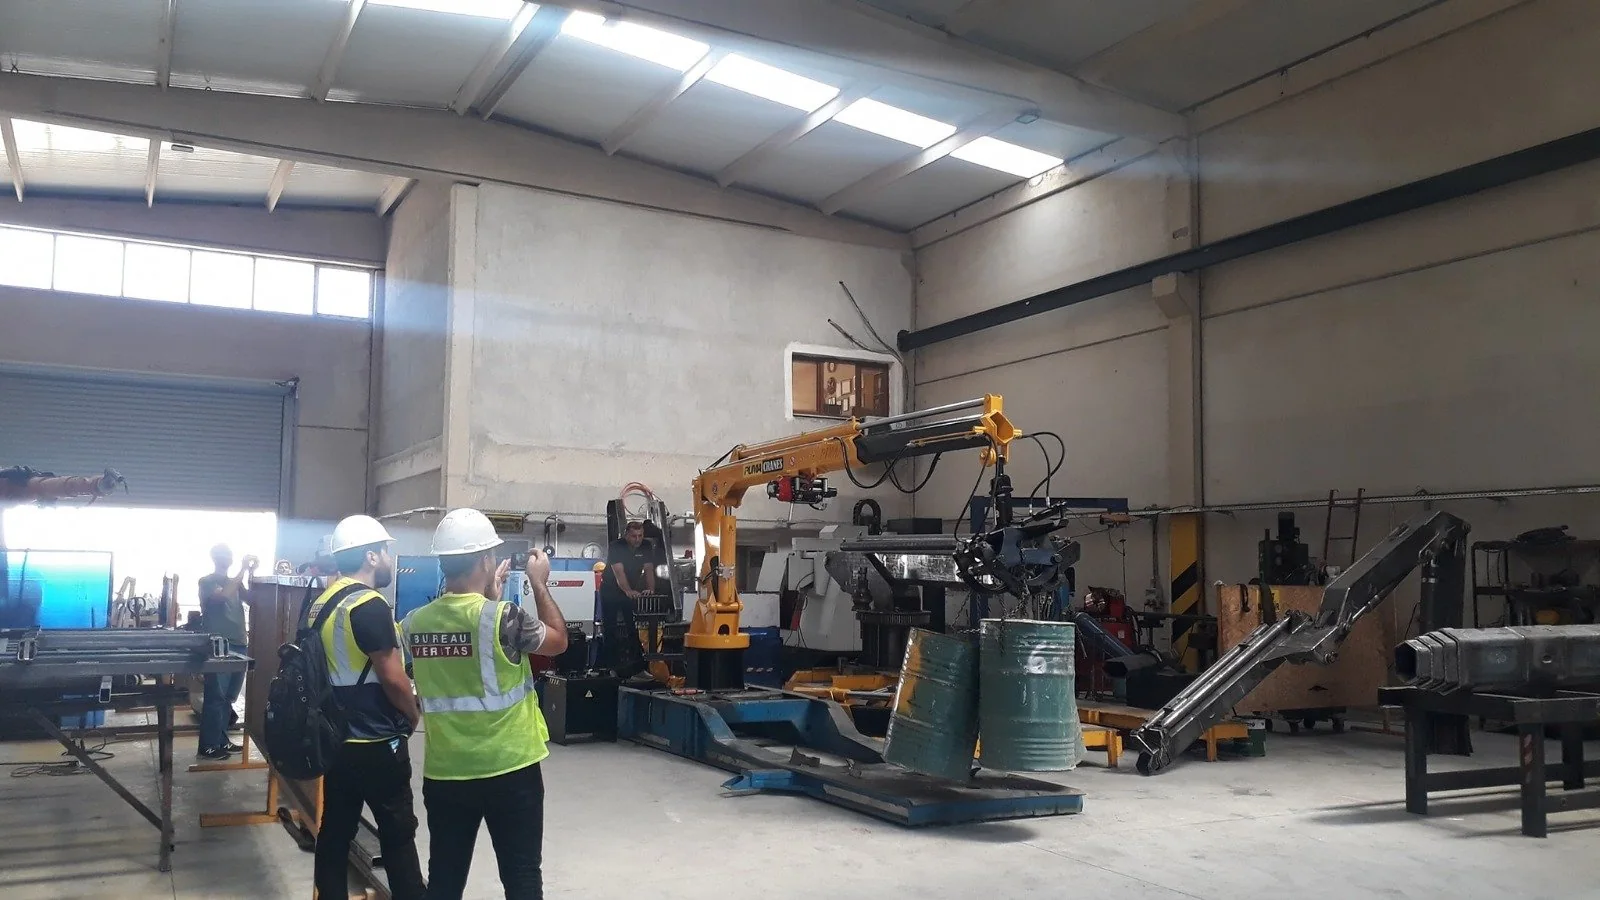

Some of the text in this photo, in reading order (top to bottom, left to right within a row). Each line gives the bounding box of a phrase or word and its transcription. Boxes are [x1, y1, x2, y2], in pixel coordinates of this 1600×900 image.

[744, 458, 783, 475] PUMA CRANES
[413, 633, 467, 644] BUREAU
[415, 646, 468, 656] VERITAS
